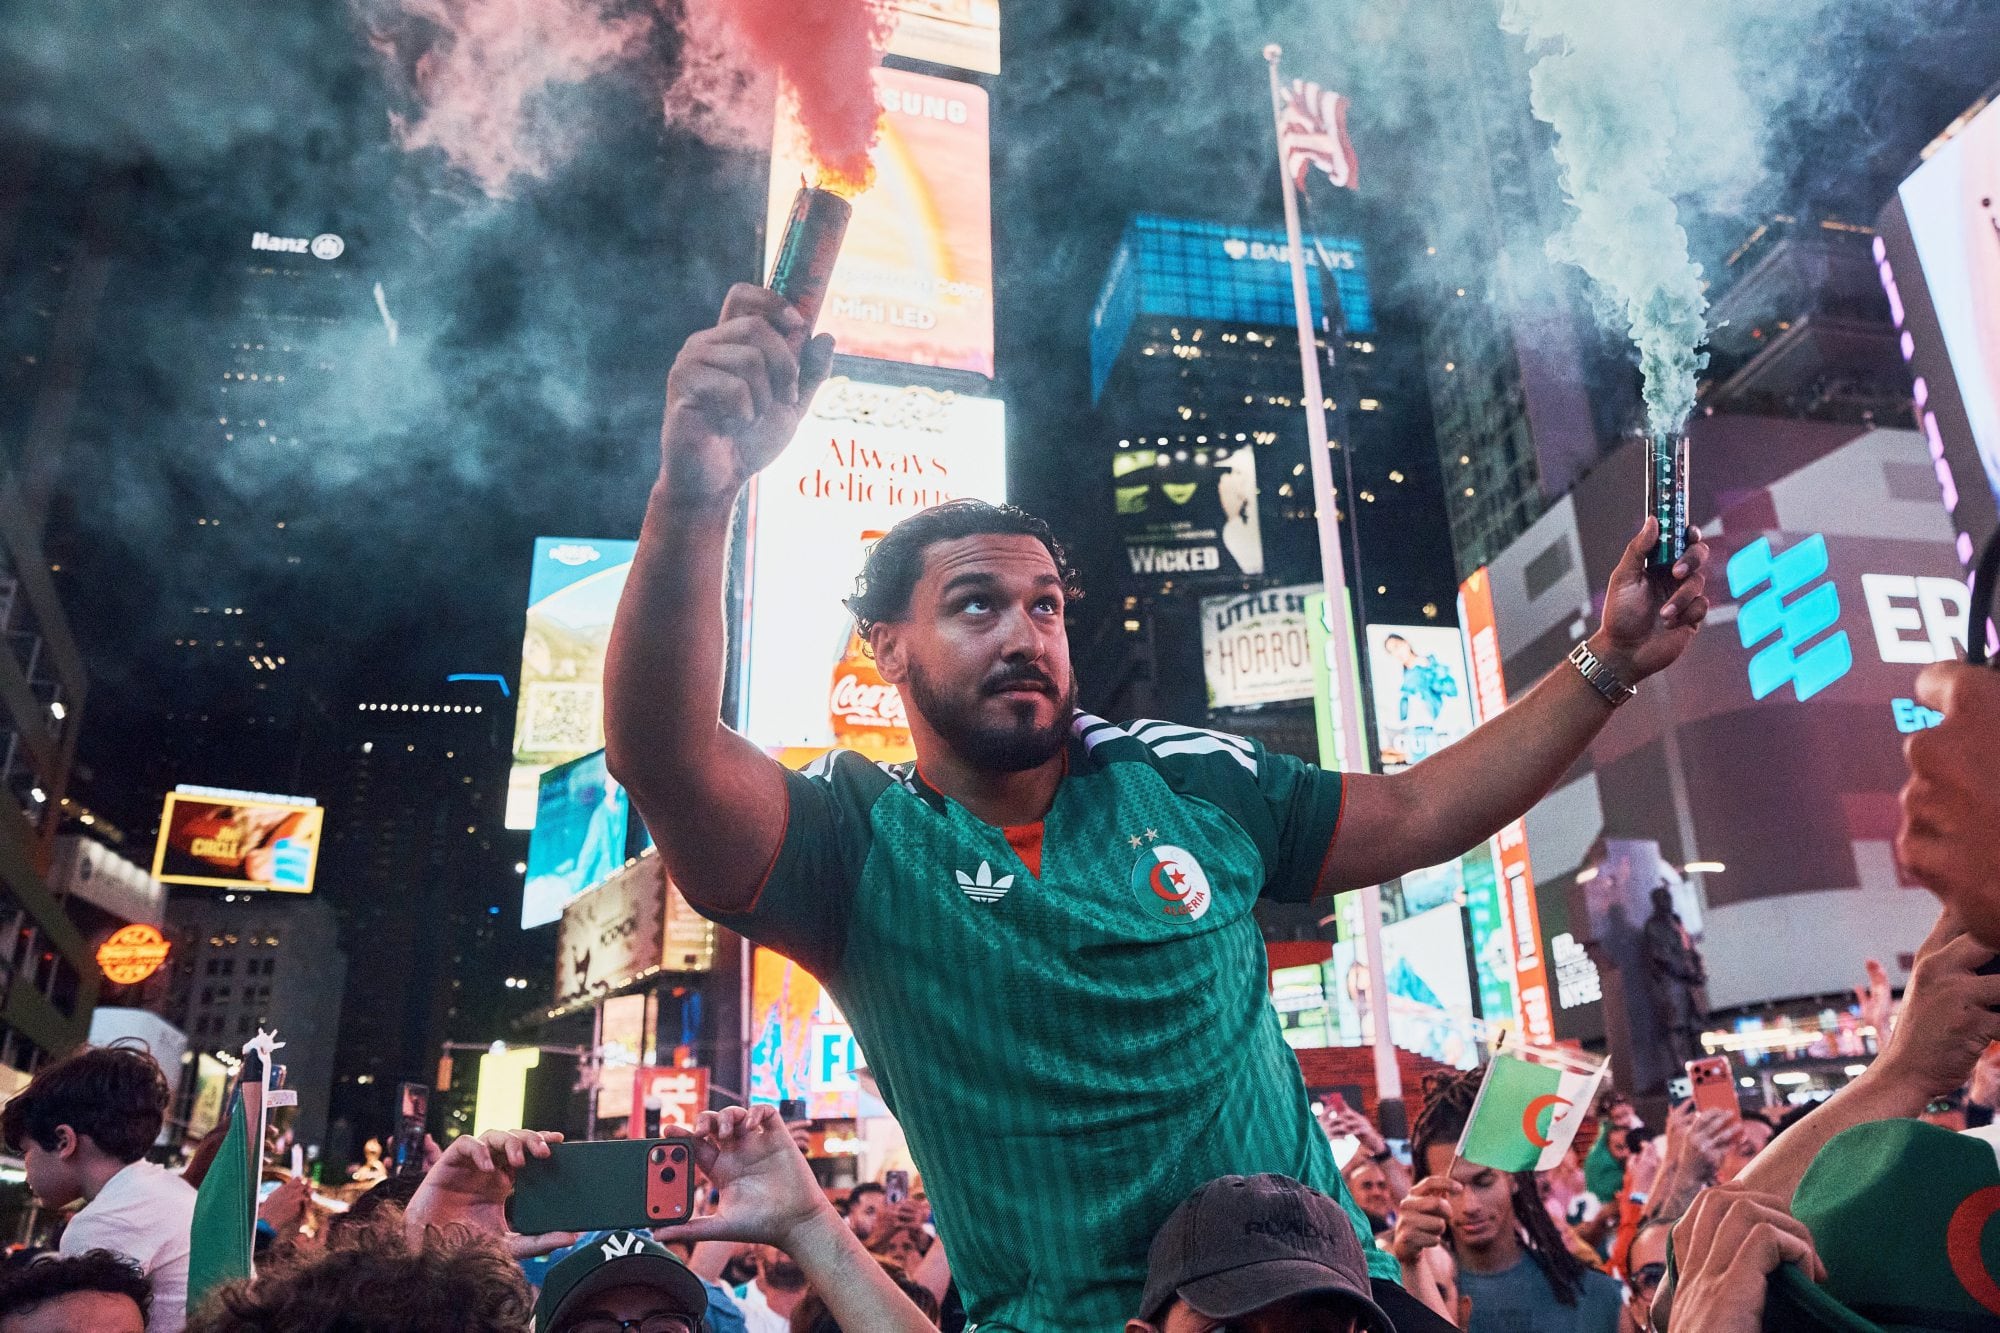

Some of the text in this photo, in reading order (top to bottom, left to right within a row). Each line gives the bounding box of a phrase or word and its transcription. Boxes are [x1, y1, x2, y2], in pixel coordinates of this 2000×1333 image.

[890, 304, 937, 330] LED
[1217, 594, 1279, 633] LITTLE
[1163, 891, 1205, 917] ALGERIA
